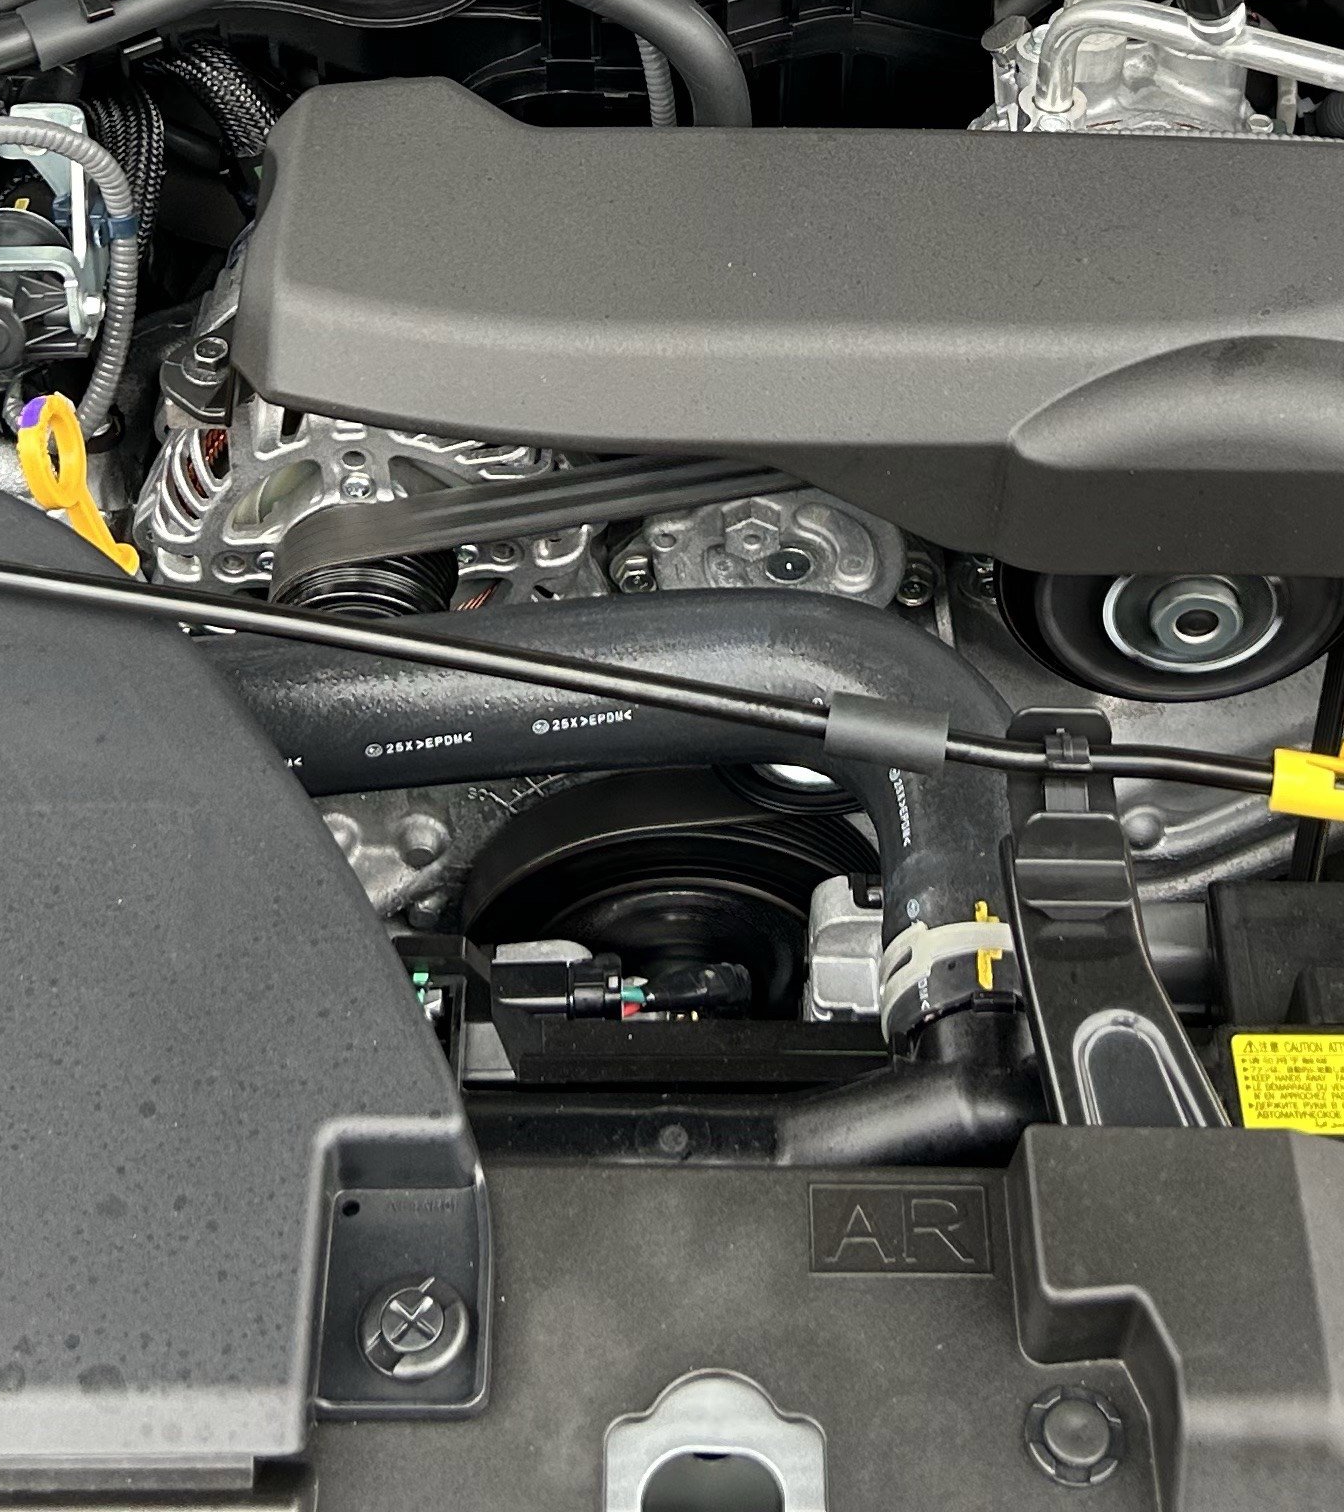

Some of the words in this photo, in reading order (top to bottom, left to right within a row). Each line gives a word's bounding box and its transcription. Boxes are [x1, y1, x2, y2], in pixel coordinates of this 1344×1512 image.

[1284, 1041, 1323, 1053] CAUTION
[1251, 1074, 1270, 1082] KEEP
[1274, 1074, 1302, 1082] HANDS
[1305, 1074, 1326, 1082] AWAY
[824, 1196, 976, 1265] AR
